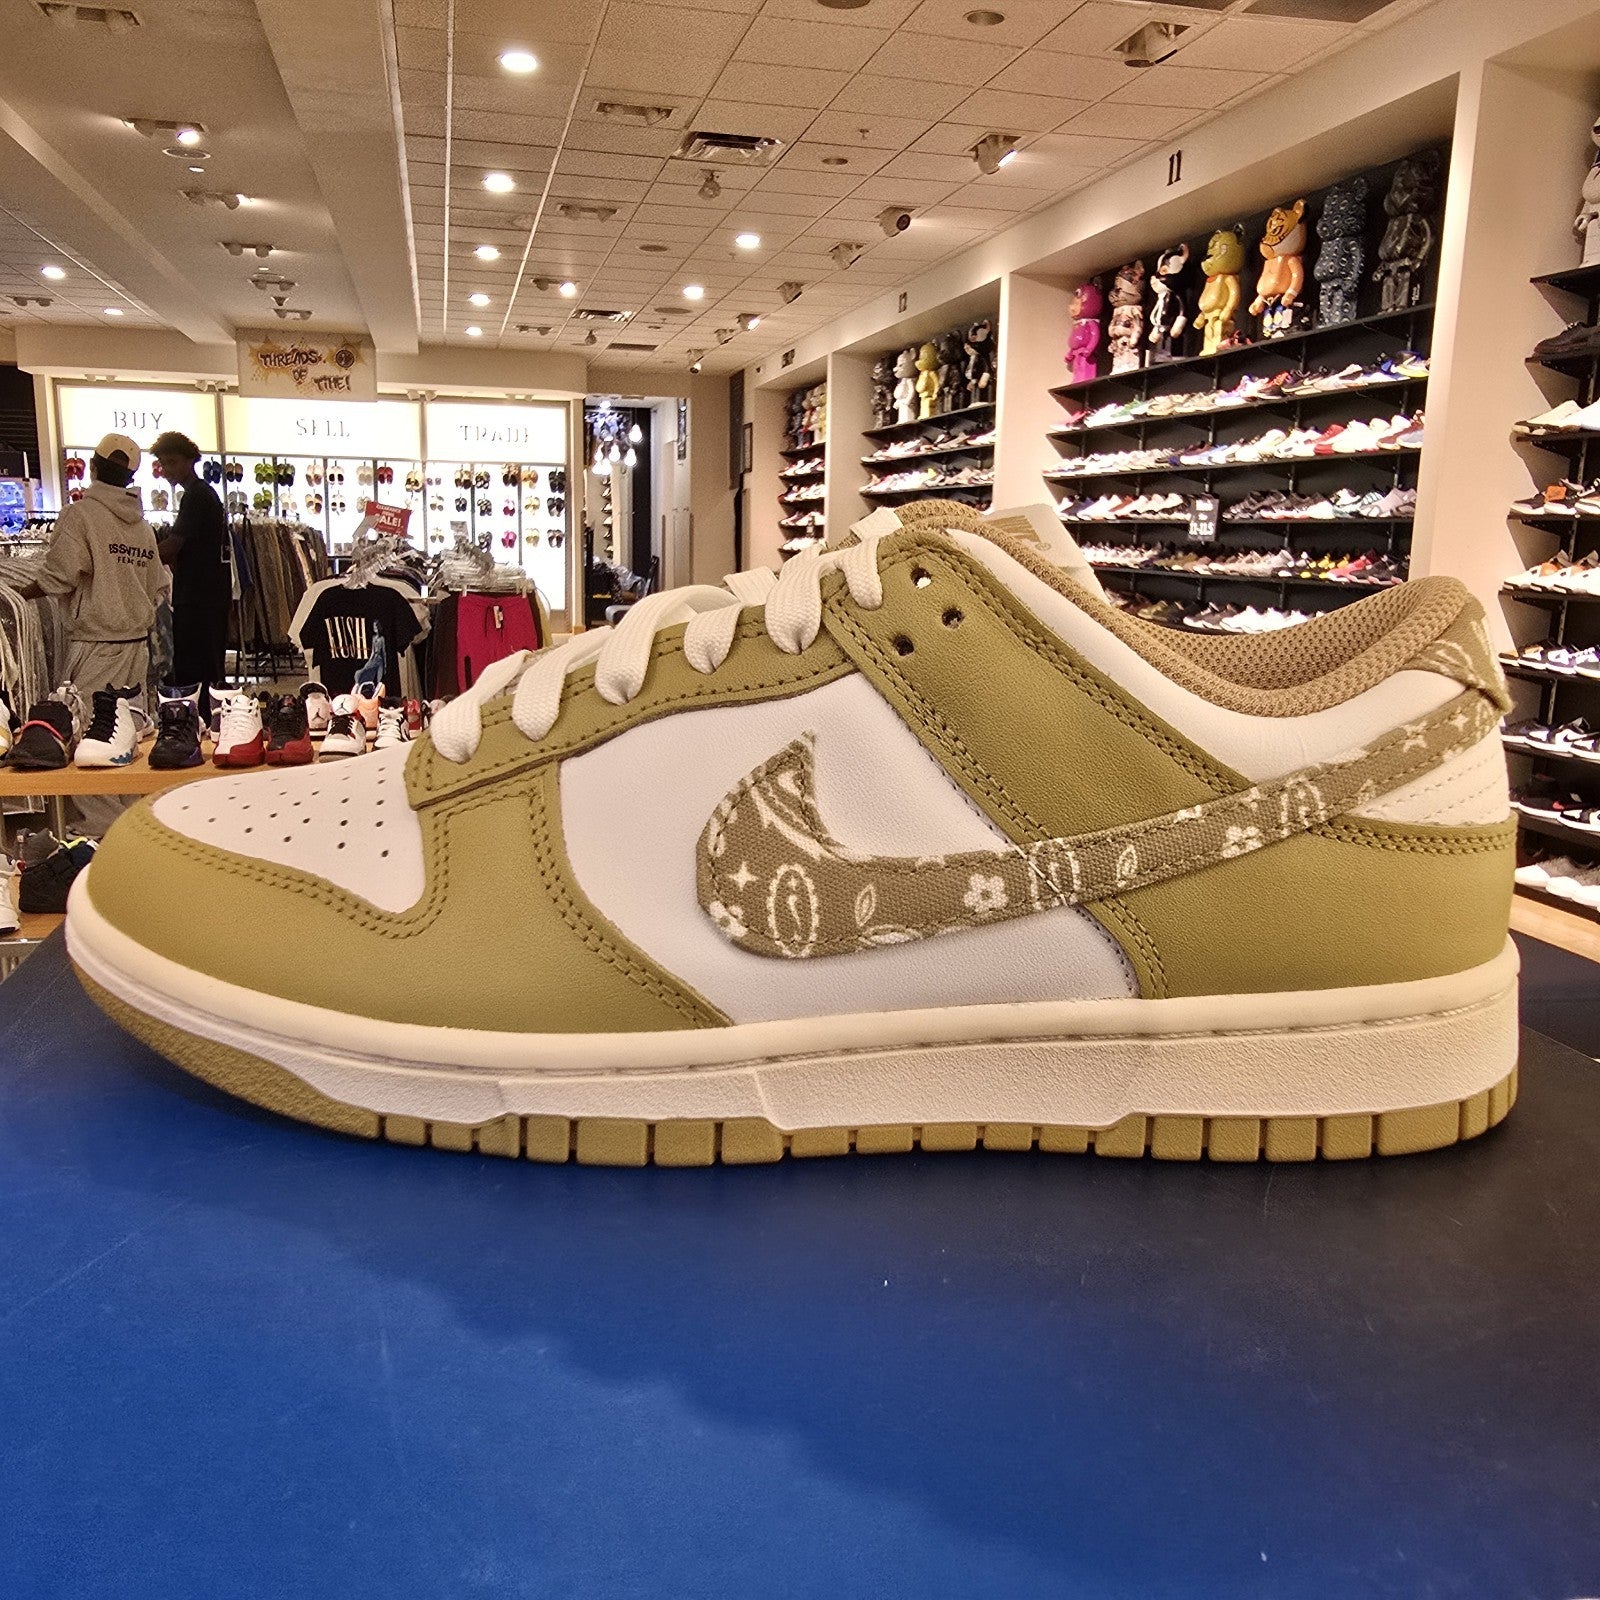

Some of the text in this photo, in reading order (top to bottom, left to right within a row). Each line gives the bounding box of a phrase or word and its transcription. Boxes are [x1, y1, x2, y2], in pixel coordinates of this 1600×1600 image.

[1166, 149, 1182, 186] 11
[113, 411, 163, 429] BUY
[296, 418, 350, 437] SELL
[375, 513, 402, 528] ALE!
